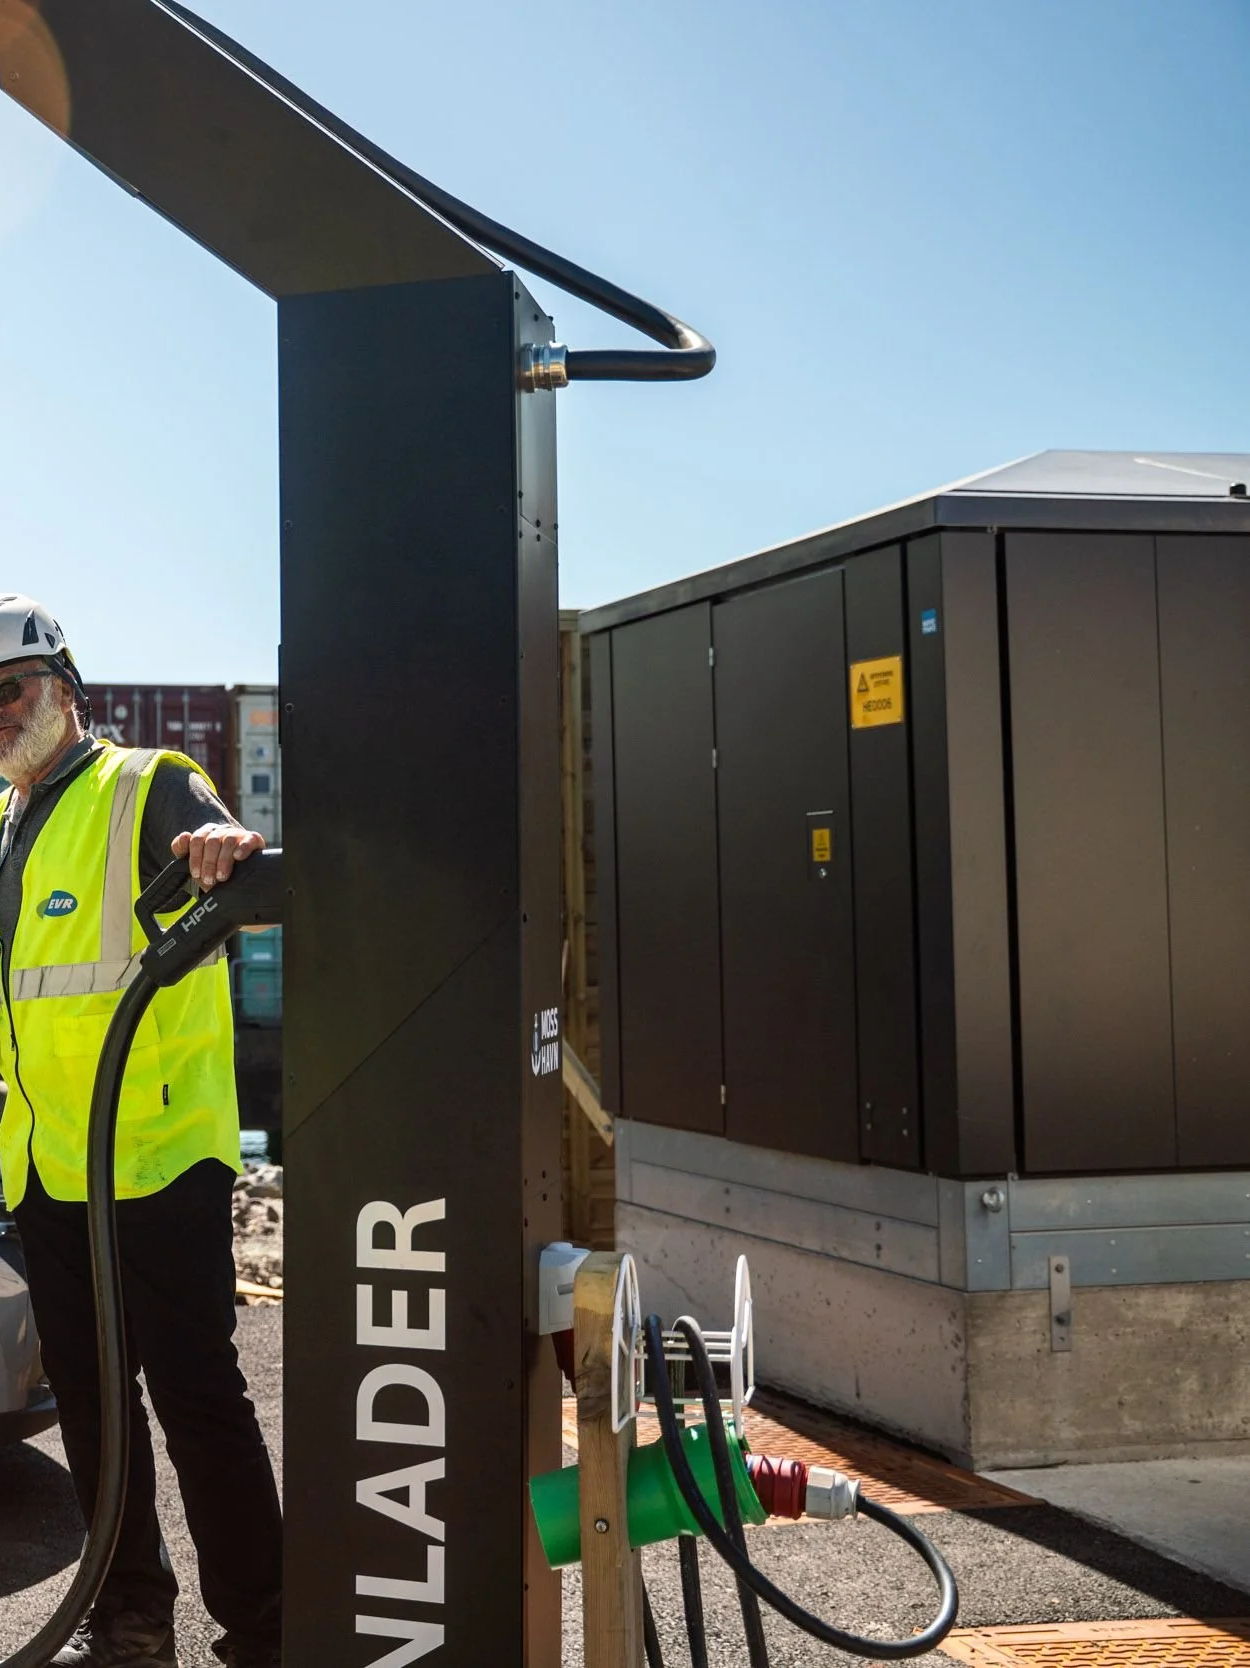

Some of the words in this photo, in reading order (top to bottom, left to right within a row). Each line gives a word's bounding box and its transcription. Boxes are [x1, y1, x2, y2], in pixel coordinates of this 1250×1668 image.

[48, 898, 74, 910] EVR
[180, 896, 219, 933] HPC
[541, 1007, 558, 1040] MOSS
[541, 1041, 559, 1076] HAVN
[356, 1198, 446, 1668] NLADER
